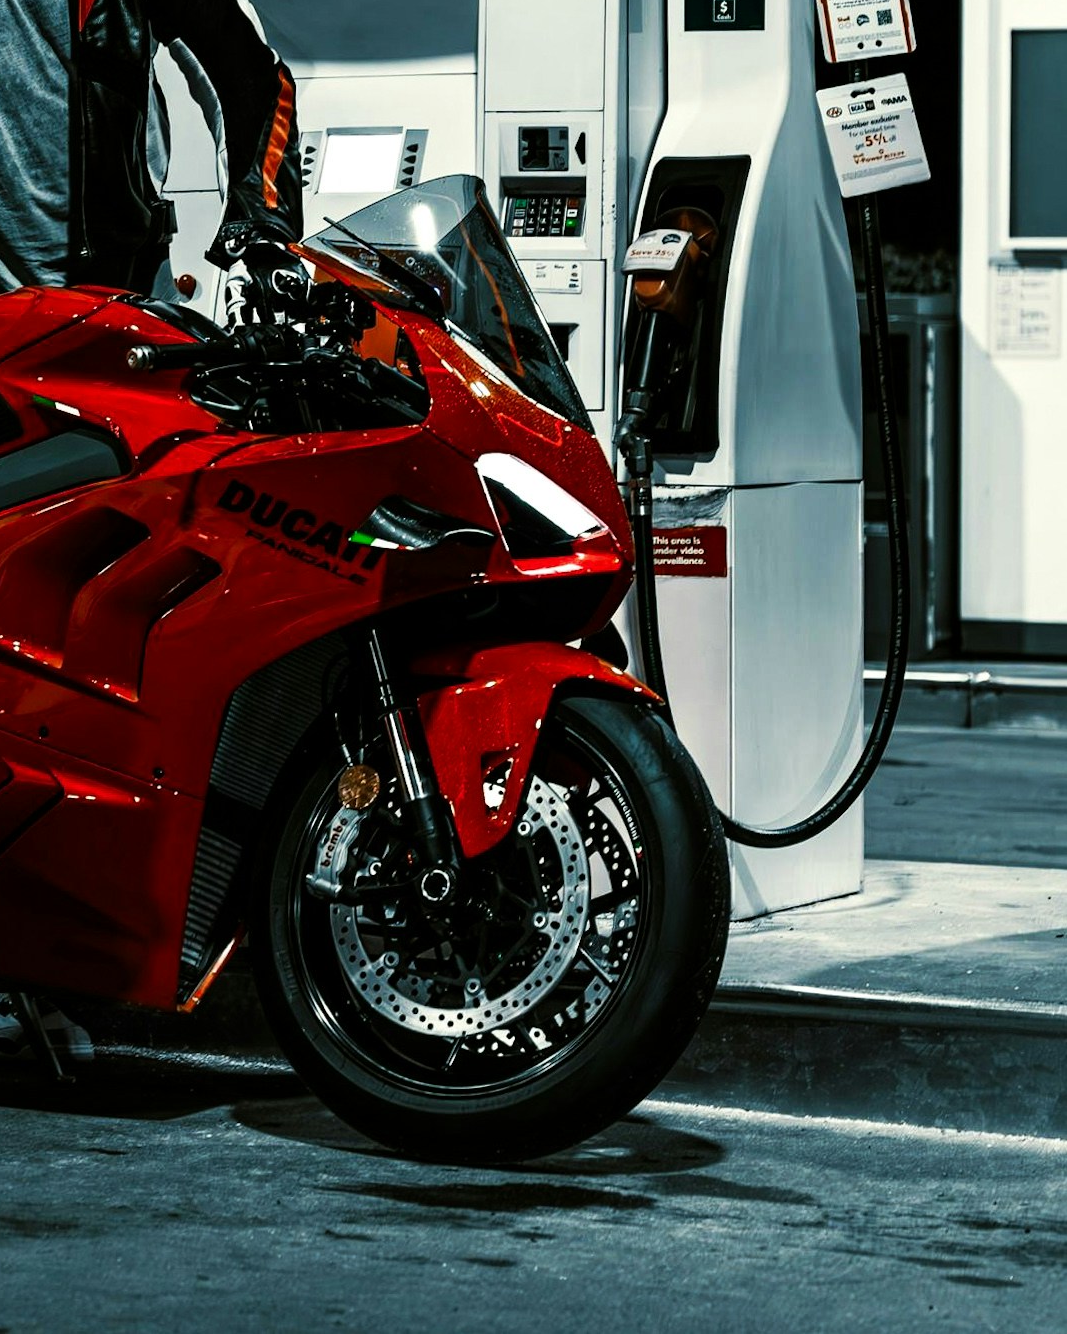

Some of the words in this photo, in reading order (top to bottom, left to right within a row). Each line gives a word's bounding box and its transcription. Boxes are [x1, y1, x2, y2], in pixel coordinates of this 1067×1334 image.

[720, 0, 728, 14] $
[887, 95, 907, 106] AMA
[841, 121, 869, 131] Member
[871, 115, 901, 125] exclusive
[217, 479, 383, 570] DUCATI
[653, 536, 669, 545] This
[693, 536, 701, 545] is
[245, 528, 369, 586] PANIGALE
[653, 546, 678, 555] under
[680, 546, 705, 555] video
[653, 556, 707, 565] surveillance.
[321, 818, 349, 868] brembo
